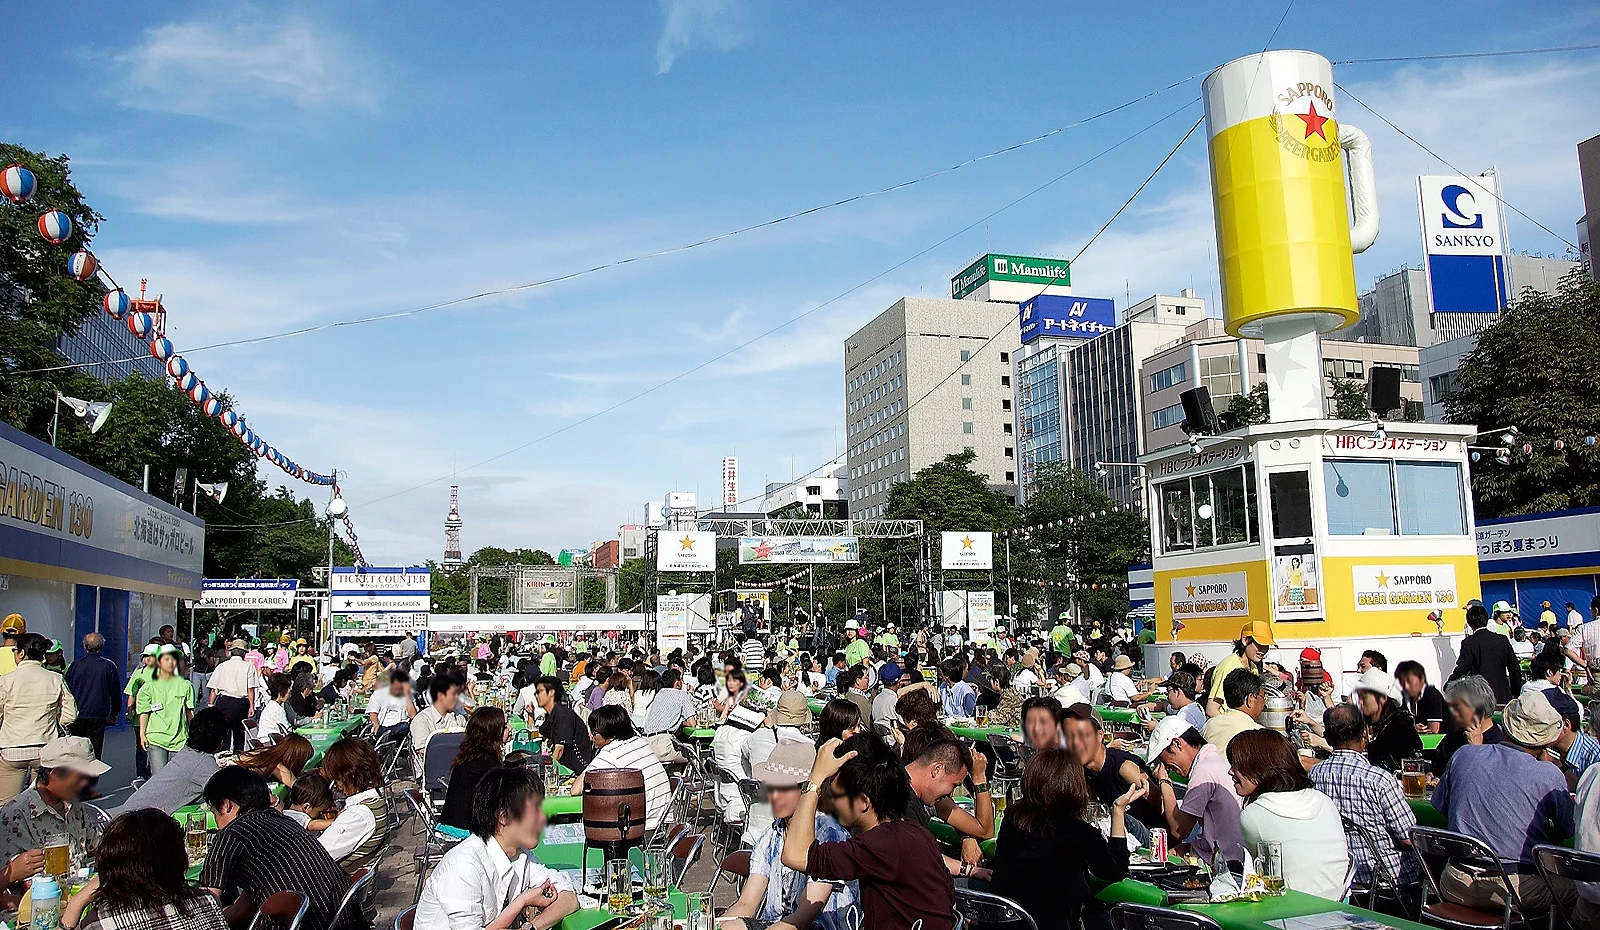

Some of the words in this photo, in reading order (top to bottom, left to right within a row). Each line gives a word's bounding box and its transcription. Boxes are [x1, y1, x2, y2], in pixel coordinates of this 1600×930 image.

[1277, 82, 1333, 111] SAPPORO
[1435, 234, 1494, 247] SANKYO
[960, 264, 987, 290] Manulife
[1011, 262, 1067, 279] Manulife
[1336, 435, 1448, 451] HBCラジオステーション
[1160, 445, 1241, 475] HBCラジオステーション
[69, 490, 94, 539] 130
[134, 515, 194, 555] 北海道はサッポロビール
[1476, 529, 1511, 541] 涼ガーデン
[1476, 535, 1559, 555] っぽろ夏まつり
[338, 575, 375, 583] TICKET
[378, 575, 426, 583] COUNTER
[1393, 575, 1432, 585] SAPPORO
[1199, 583, 1228, 594] SAPPORO
[1174, 601, 1194, 613] BEER
[1195, 598, 1227, 612] GARDEN
[1229, 597, 1245, 610] 130
[1358, 592, 1387, 605] BEER
[1389, 591, 1432, 604] GARDEN
[1435, 590, 1454, 602] 130
